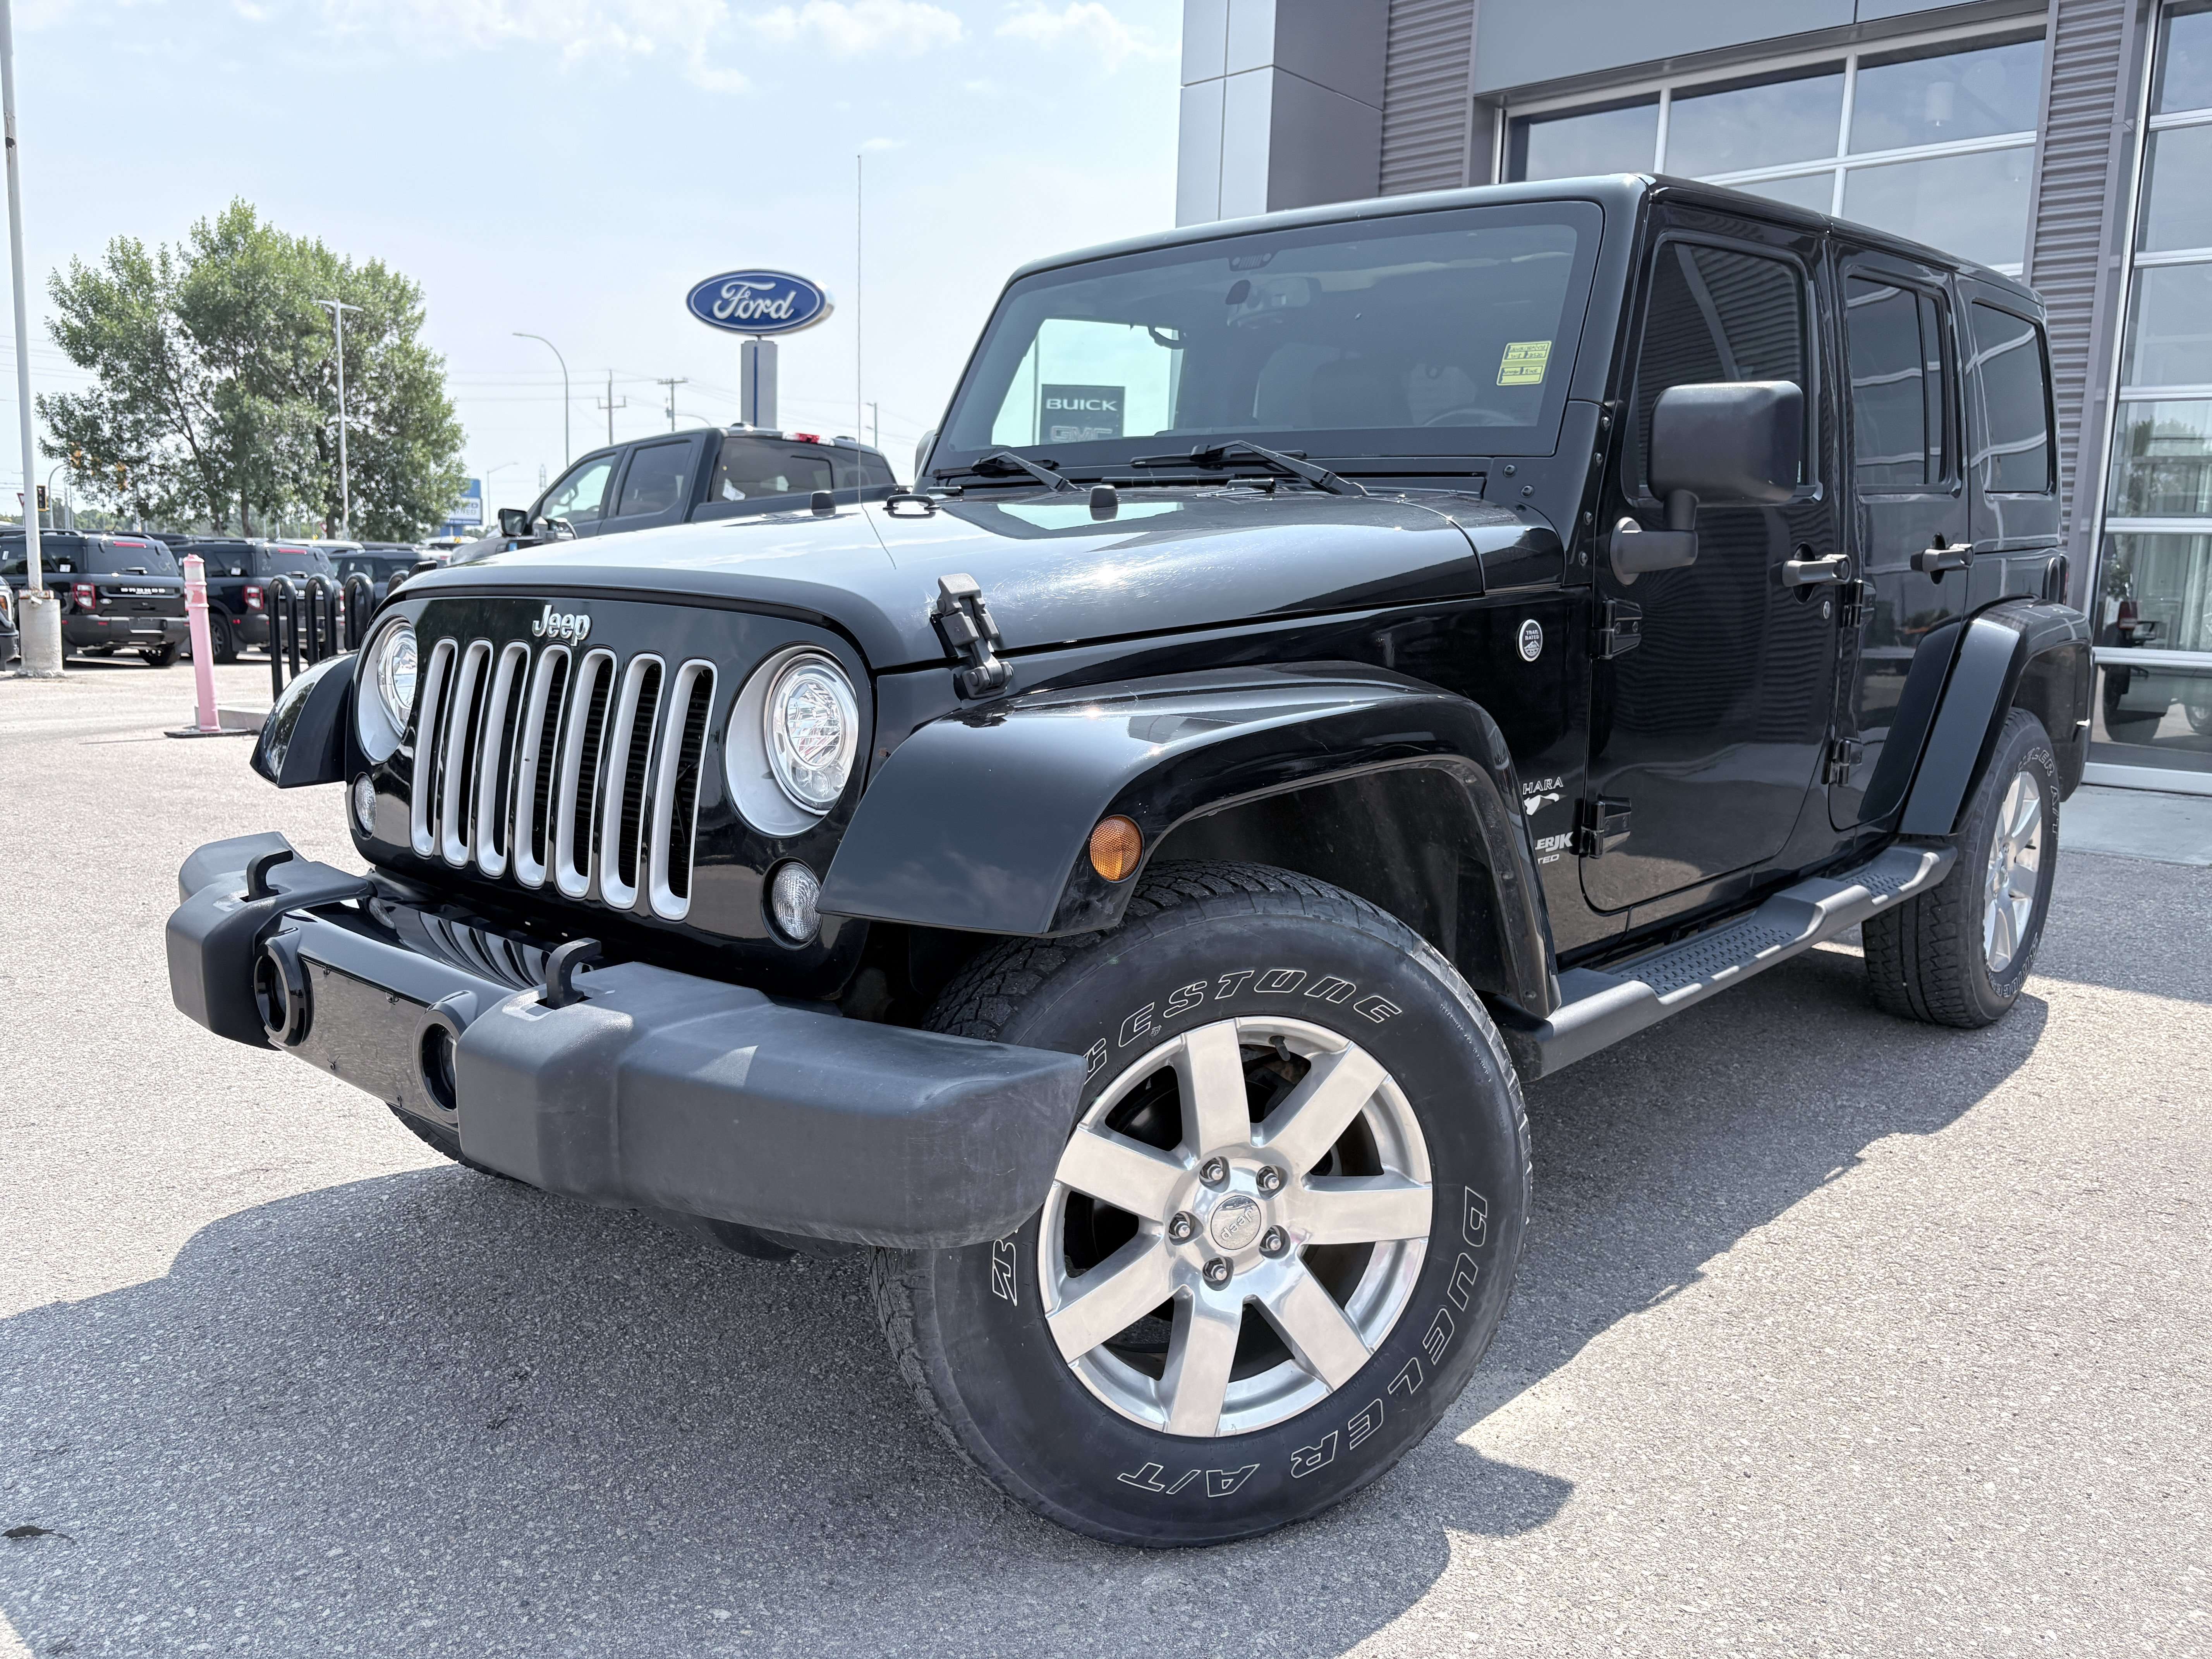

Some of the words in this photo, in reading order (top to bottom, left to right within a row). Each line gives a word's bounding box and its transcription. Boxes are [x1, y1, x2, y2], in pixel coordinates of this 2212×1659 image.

[713, 281, 797, 319] Ford
[1046, 398, 1118, 411] BUICK
[533, 605, 591, 646] Jeep
[1522, 776, 1564, 795] HARA
[1220, 1206, 1254, 1241] Jeep
[1290, 1186, 1488, 1479] DUELER
[1116, 1462, 1261, 1498] A/T
